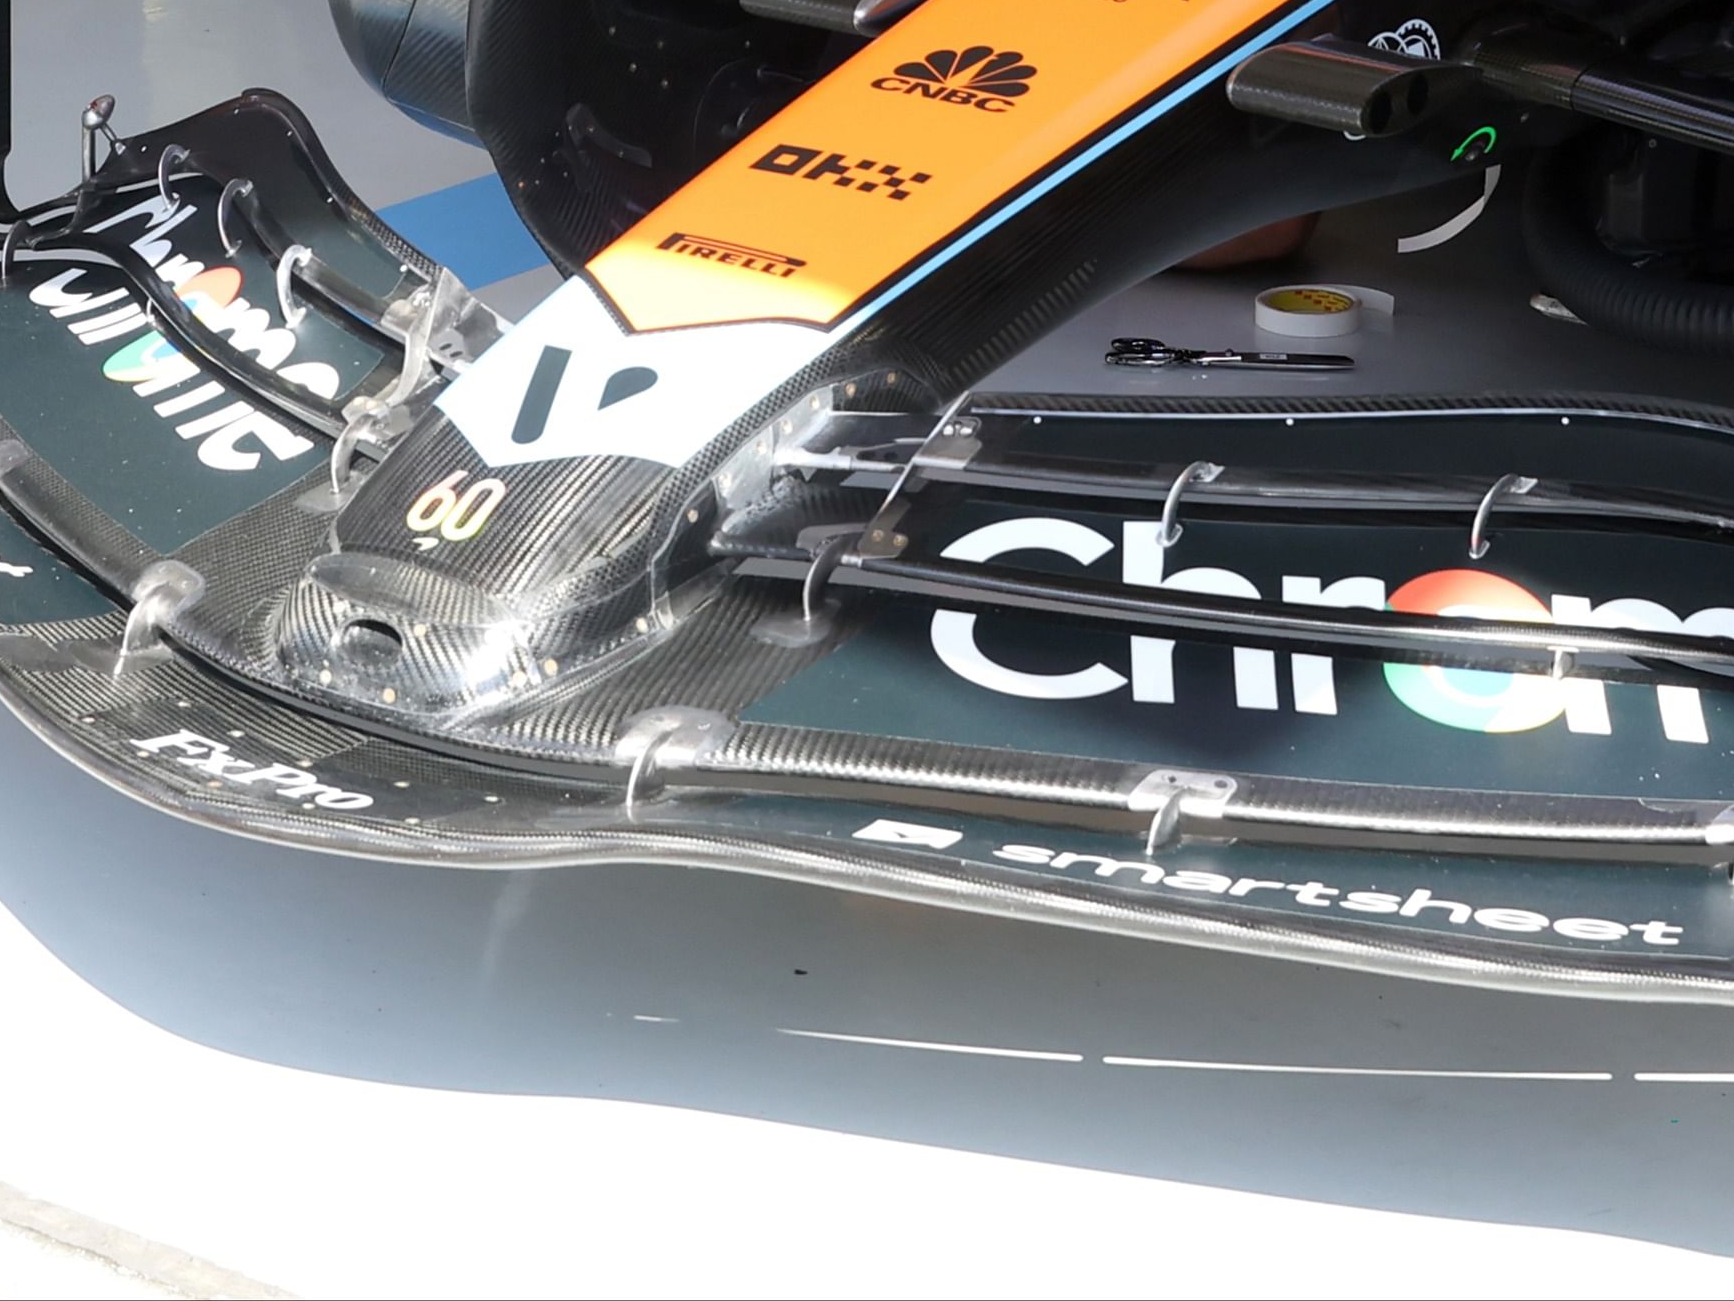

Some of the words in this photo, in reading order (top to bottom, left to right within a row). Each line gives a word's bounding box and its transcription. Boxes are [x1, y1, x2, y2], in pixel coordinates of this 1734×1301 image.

[870, 76, 1016, 114] CNBC
[749, 144, 932, 200] OKX
[656, 232, 808, 279] PIRELLI
[129, 728, 375, 811] FxPro
[992, 839, 1686, 947] smartsheet
